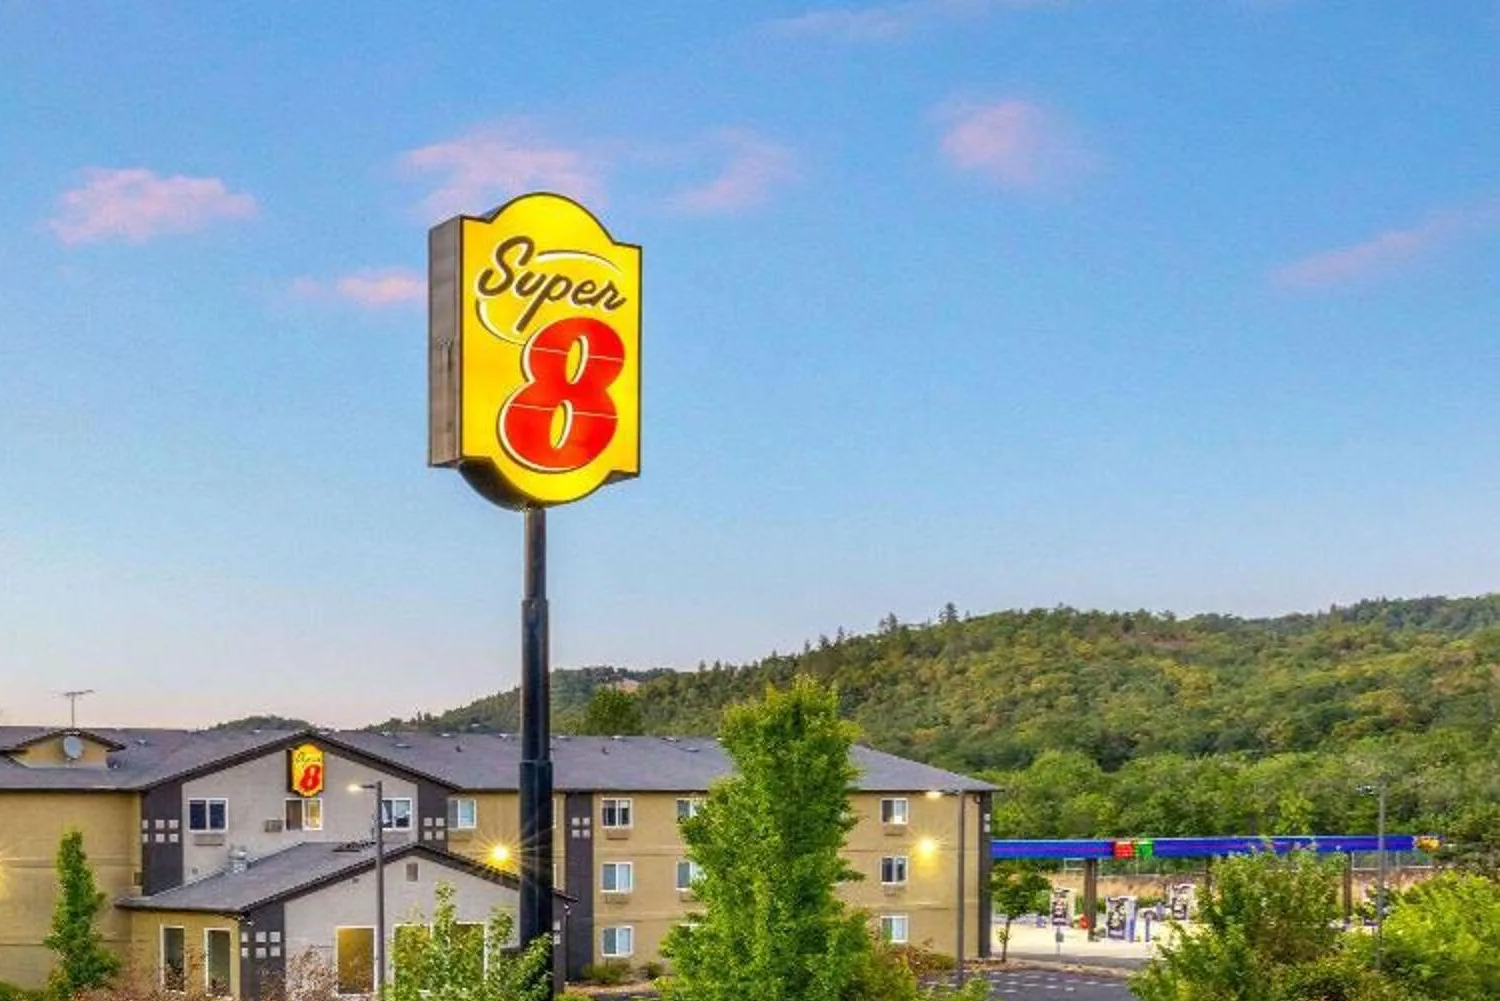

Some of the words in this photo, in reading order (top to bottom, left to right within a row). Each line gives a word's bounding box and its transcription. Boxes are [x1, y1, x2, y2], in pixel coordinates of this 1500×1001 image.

[477, 235, 628, 333] Super
[497, 316, 625, 474] 8
[300, 764, 321, 792] 8
